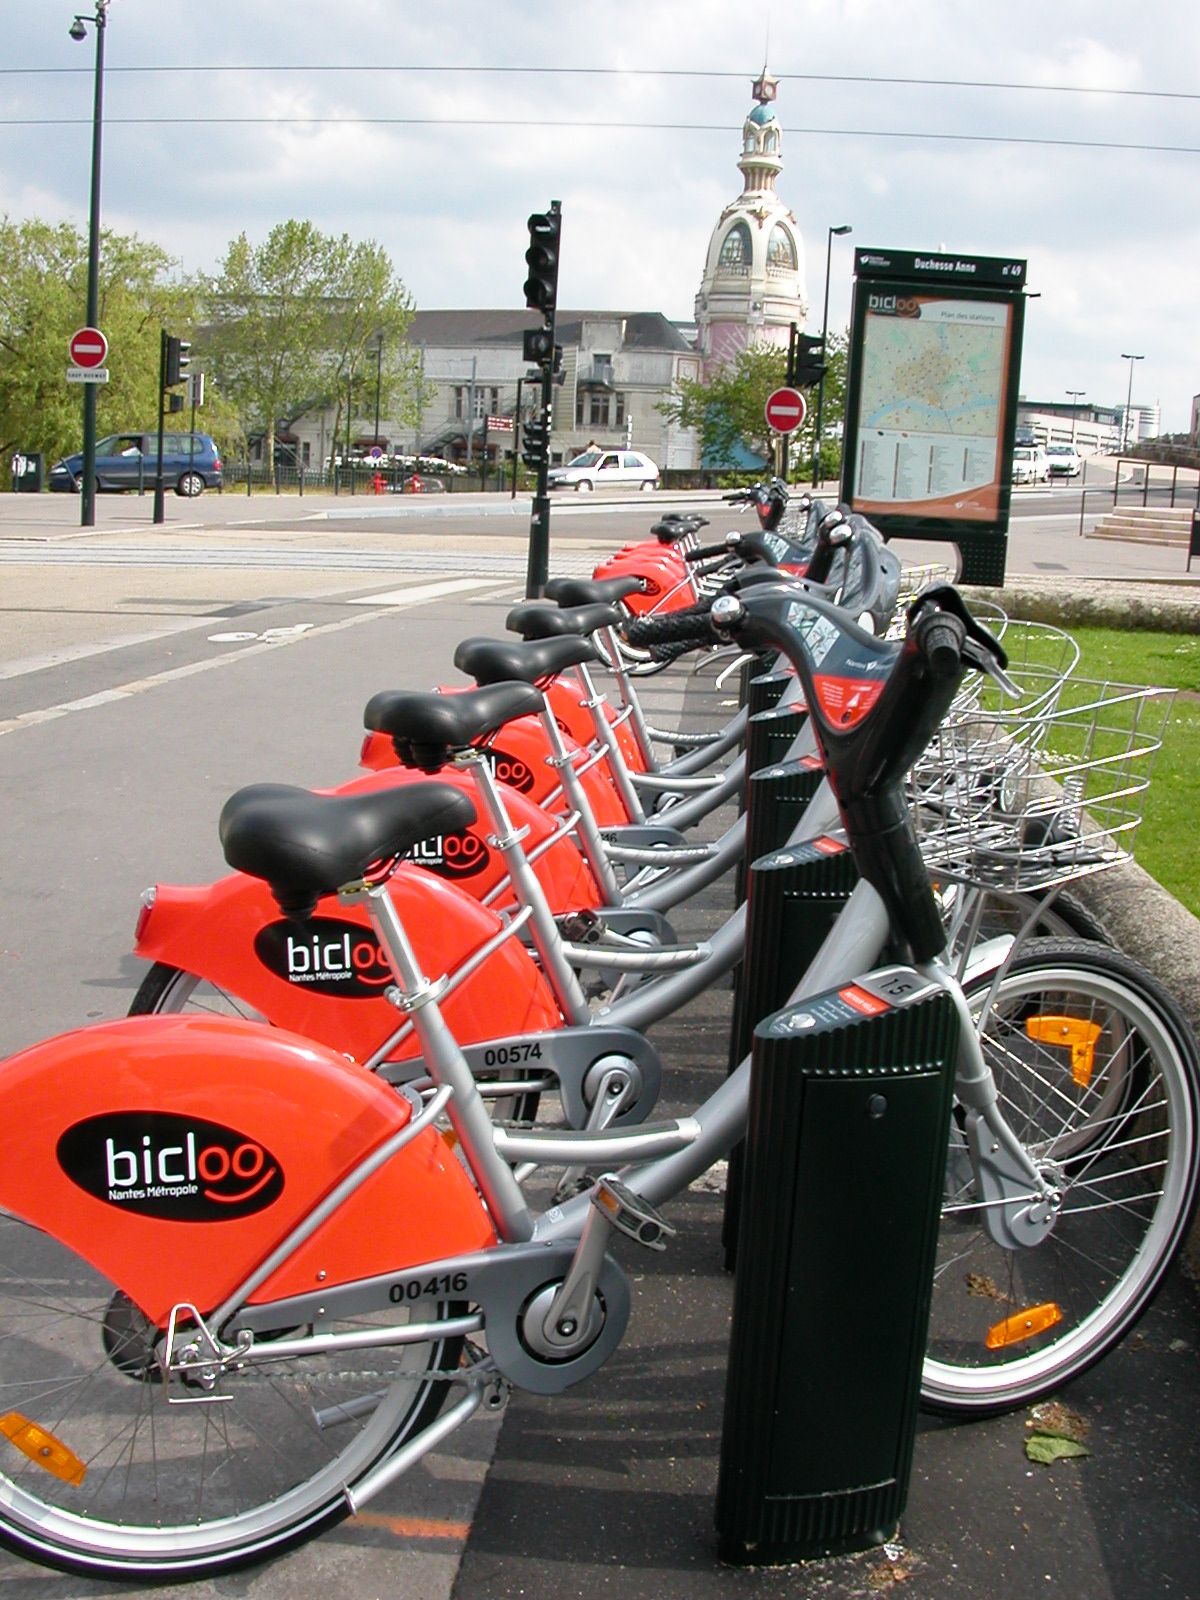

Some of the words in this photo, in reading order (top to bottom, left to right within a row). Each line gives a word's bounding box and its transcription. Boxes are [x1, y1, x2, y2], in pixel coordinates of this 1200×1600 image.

[914, 257, 954, 272] Duchesse
[955, 261, 976, 273] Anne
[1011, 264, 1022, 277] 49
[868, 293, 917, 311] bicloo
[941, 311, 955, 320] Plan
[957, 312, 968, 320] des
[969, 313, 995, 322] stations
[289, 971, 315, 982] Nantes
[316, 970, 352, 982] Métropole
[880, 978, 912, 996] 15
[484, 1042, 543, 1067] 00574
[106, 1132, 264, 1187] bicloo
[108, 1188, 146, 1201] Nantes
[147, 1183, 199, 1198] Métropole
[388, 1272, 468, 1303] 00416
